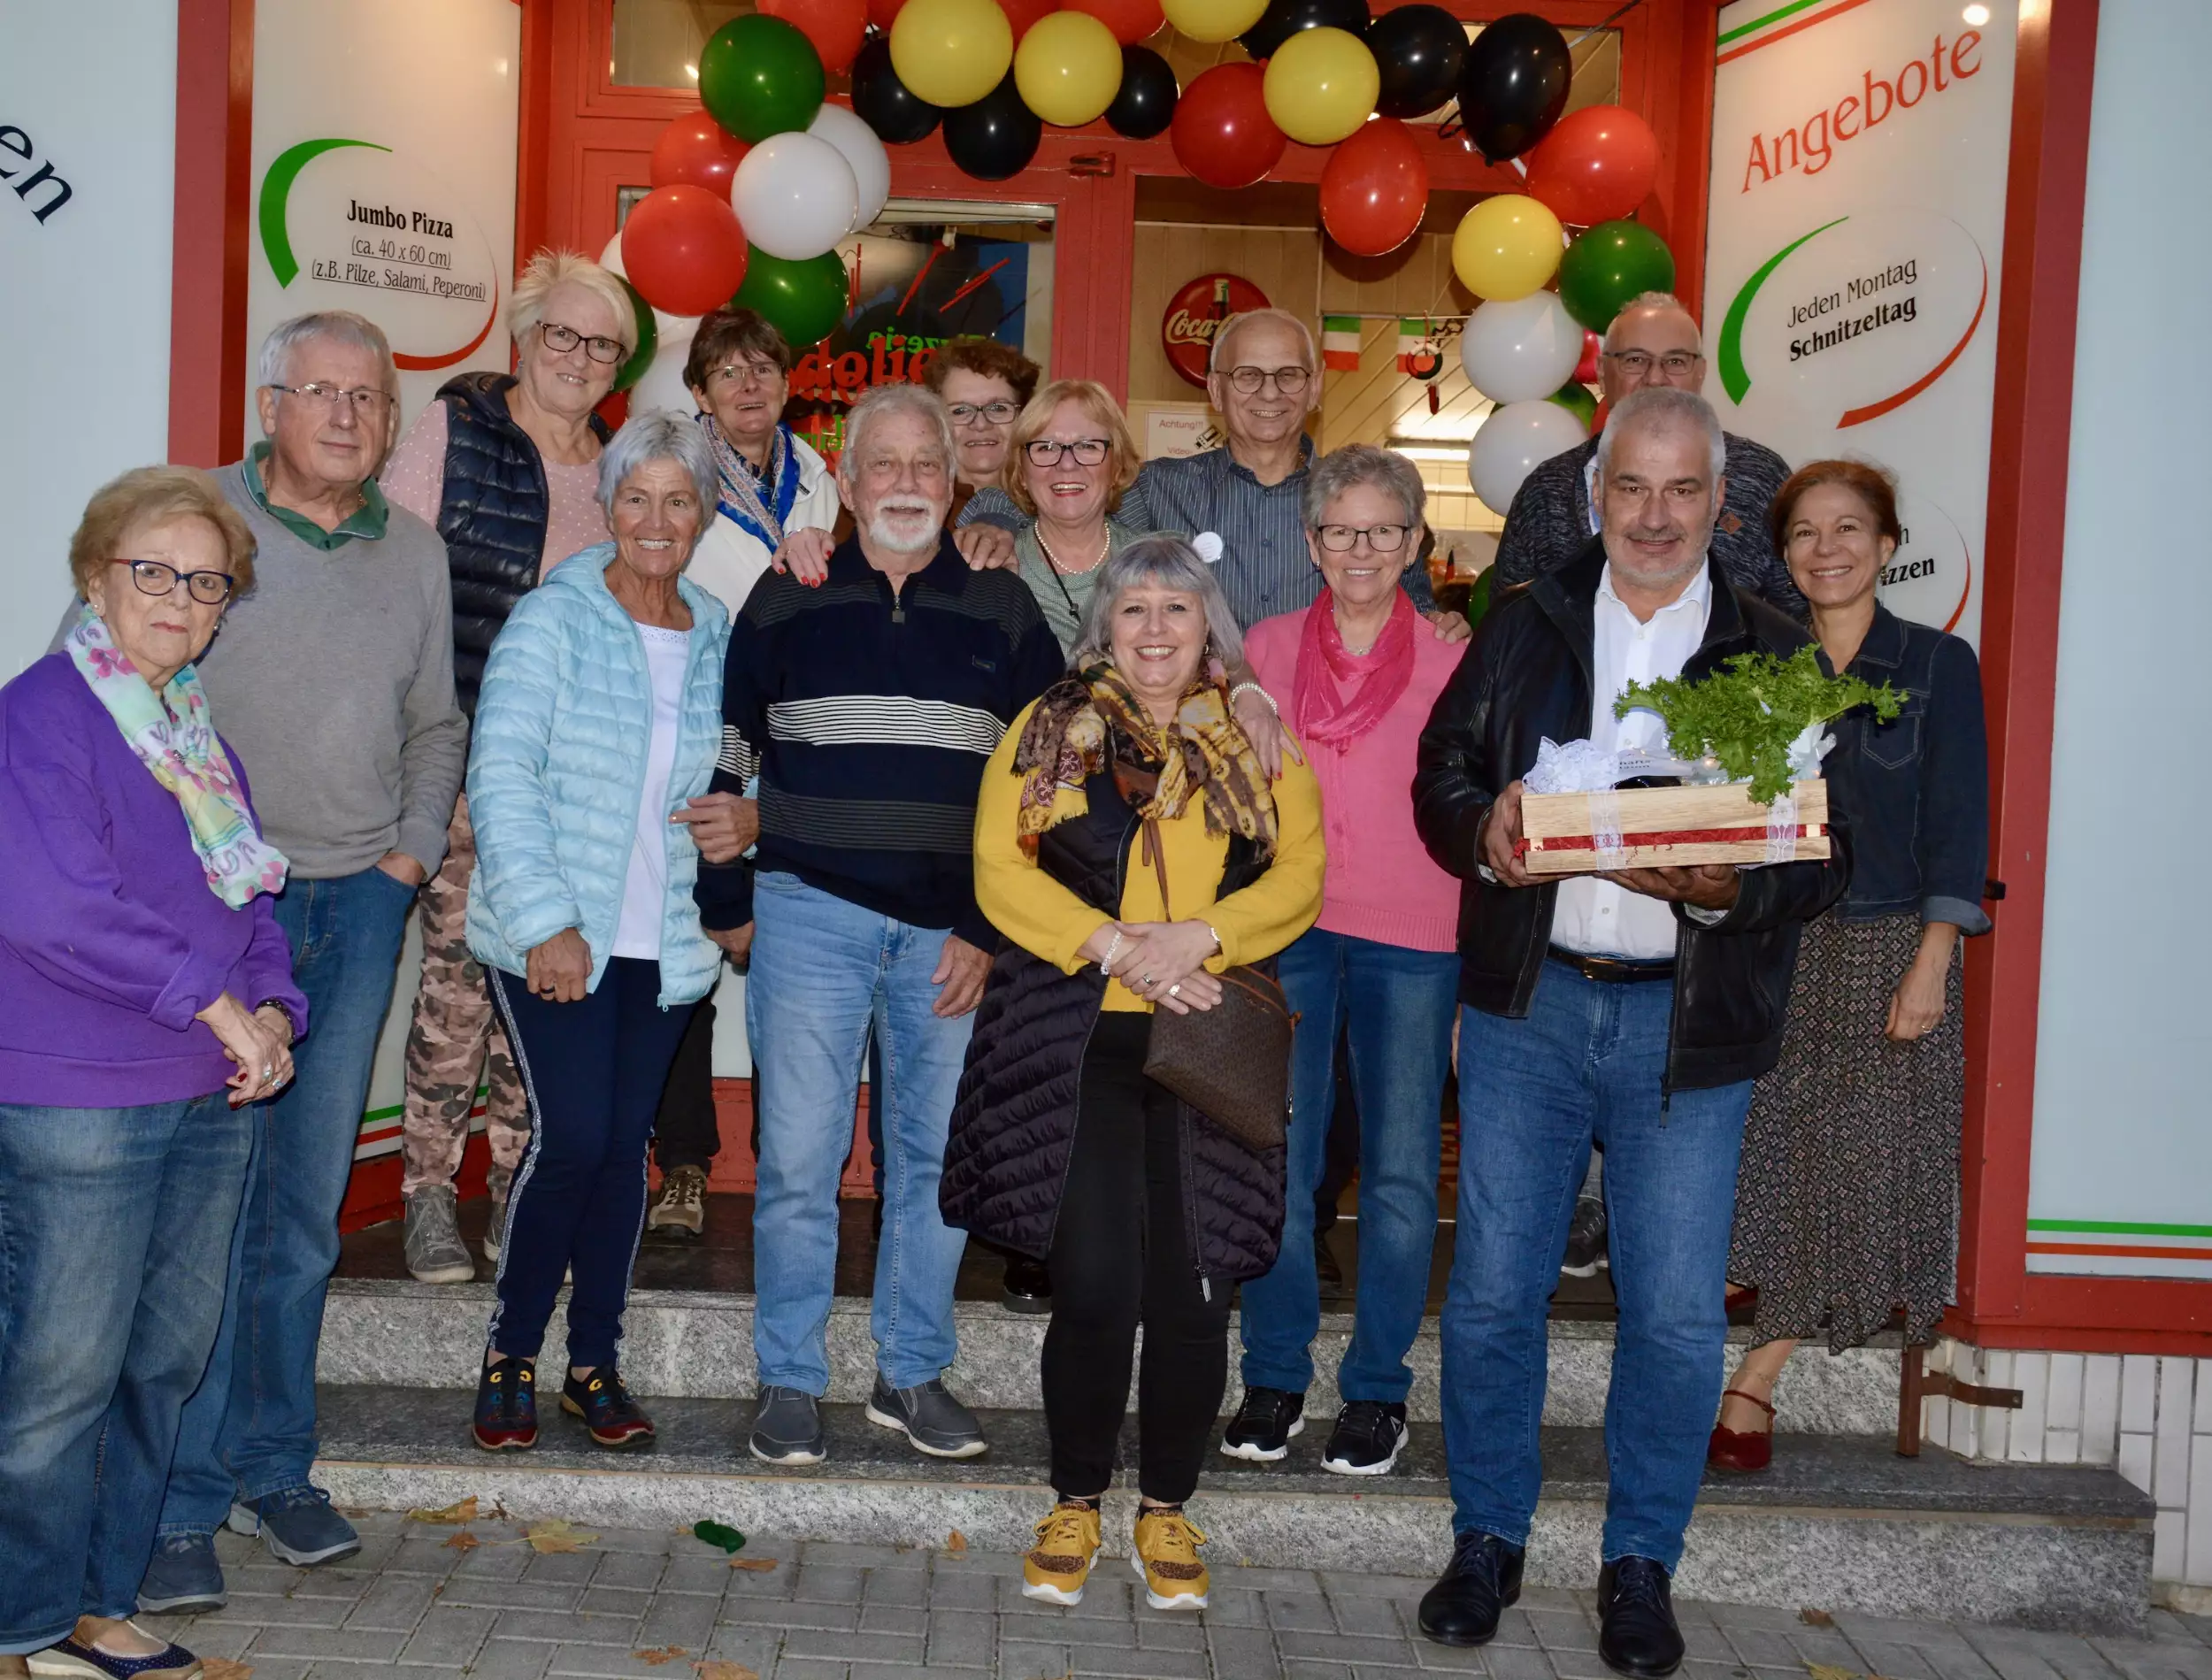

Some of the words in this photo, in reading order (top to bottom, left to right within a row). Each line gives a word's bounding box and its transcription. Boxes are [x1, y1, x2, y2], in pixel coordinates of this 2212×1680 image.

[1741, 30, 1982, 194] Angebote
[347, 199, 406, 230] Jumbo
[412, 211, 453, 238] Pizza
[351, 235, 374, 256] (ca.
[379, 239, 395, 258] 40
[398, 246, 406, 260] x
[409, 244, 425, 263] 60
[428, 250, 451, 270] cm)
[311, 258, 341, 280] (z.B.
[346, 263, 380, 287] Pilze,
[383, 268, 428, 294] Salami,
[433, 275, 487, 302] Peperoni)
[1787, 292, 1840, 328] Jeden
[1847, 258, 1916, 303] Montag
[1789, 296, 1916, 362] Schnitzeltag
[1158, 418, 1203, 431] Achtung!!!
